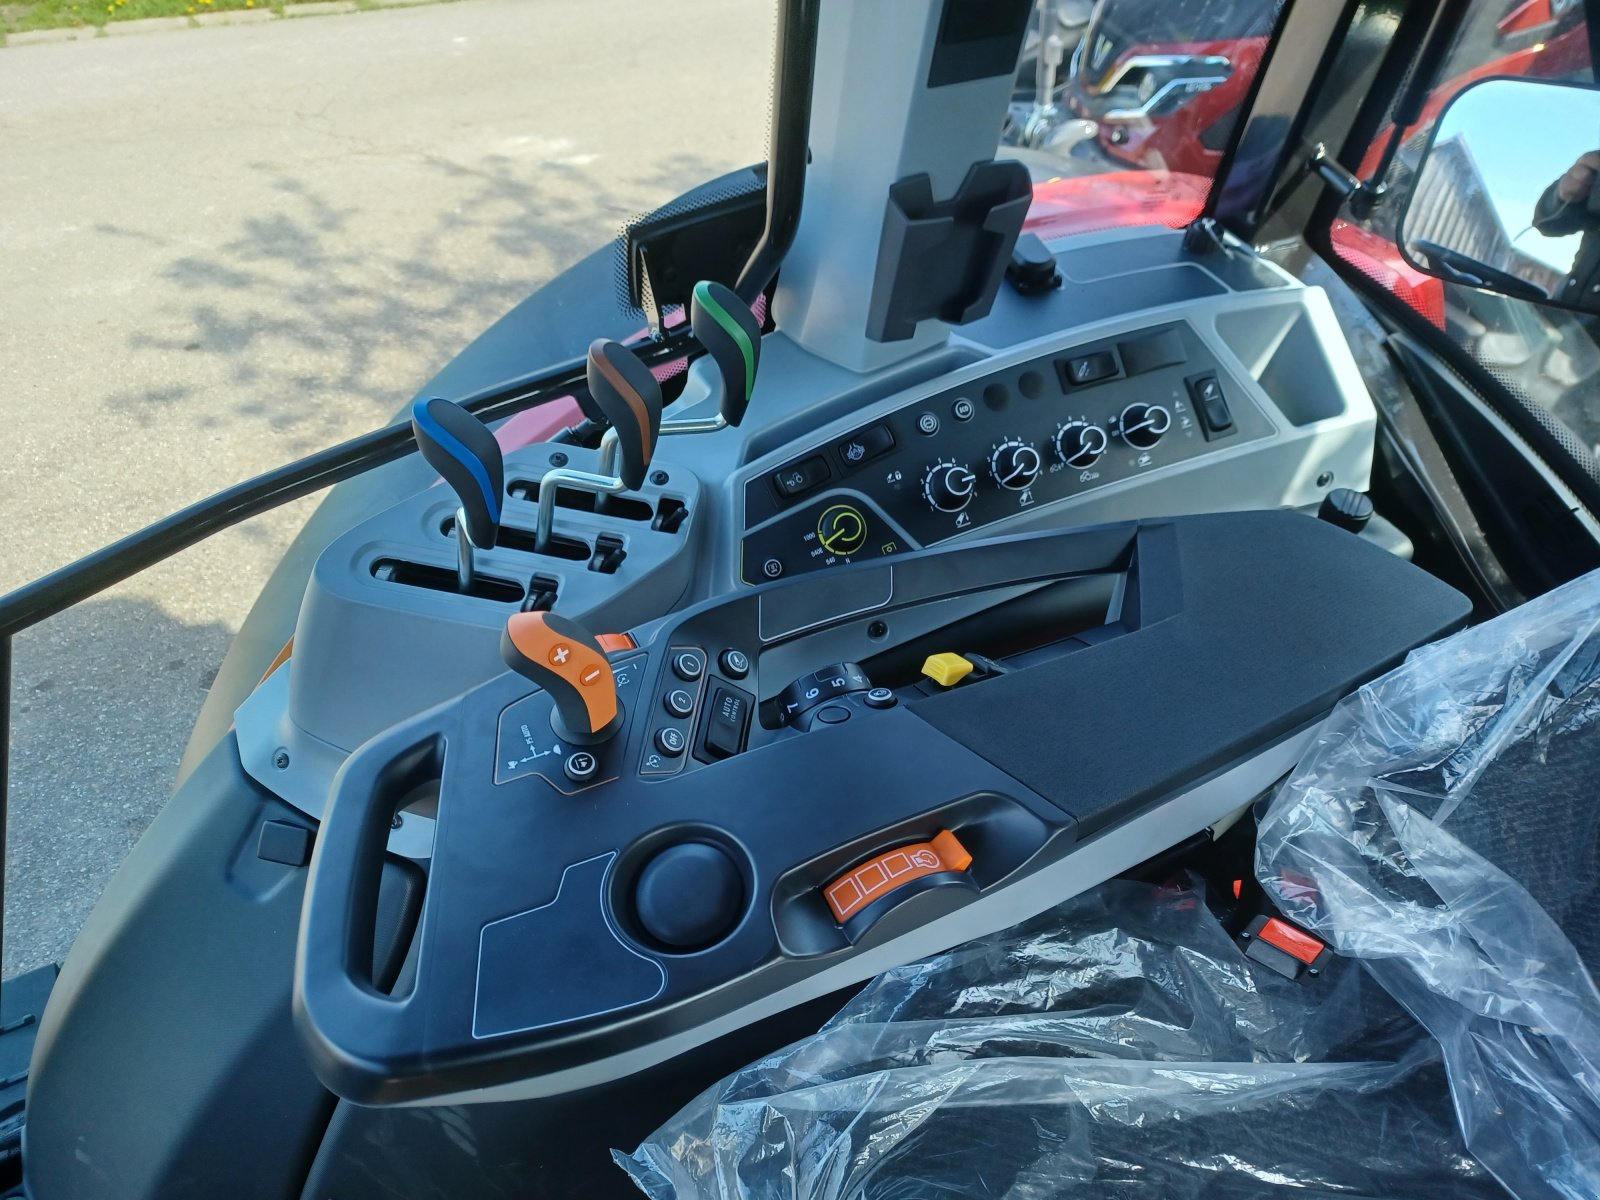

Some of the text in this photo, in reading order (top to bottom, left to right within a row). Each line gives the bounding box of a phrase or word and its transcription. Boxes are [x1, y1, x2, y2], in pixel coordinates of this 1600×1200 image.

[958, 404, 969, 414] ECO
[803, 531, 816, 542] 1000
[825, 556, 836, 566] 540
[831, 677, 846, 688] 5
[852, 674, 863, 683] 4
[805, 687, 820, 700] 6
[678, 696, 686, 704] 2
[722, 696, 733, 718] AUTO
[730, 698, 741, 722] CONTROL
[786, 702, 799, 714] 7
[669, 731, 679, 746] OFF
